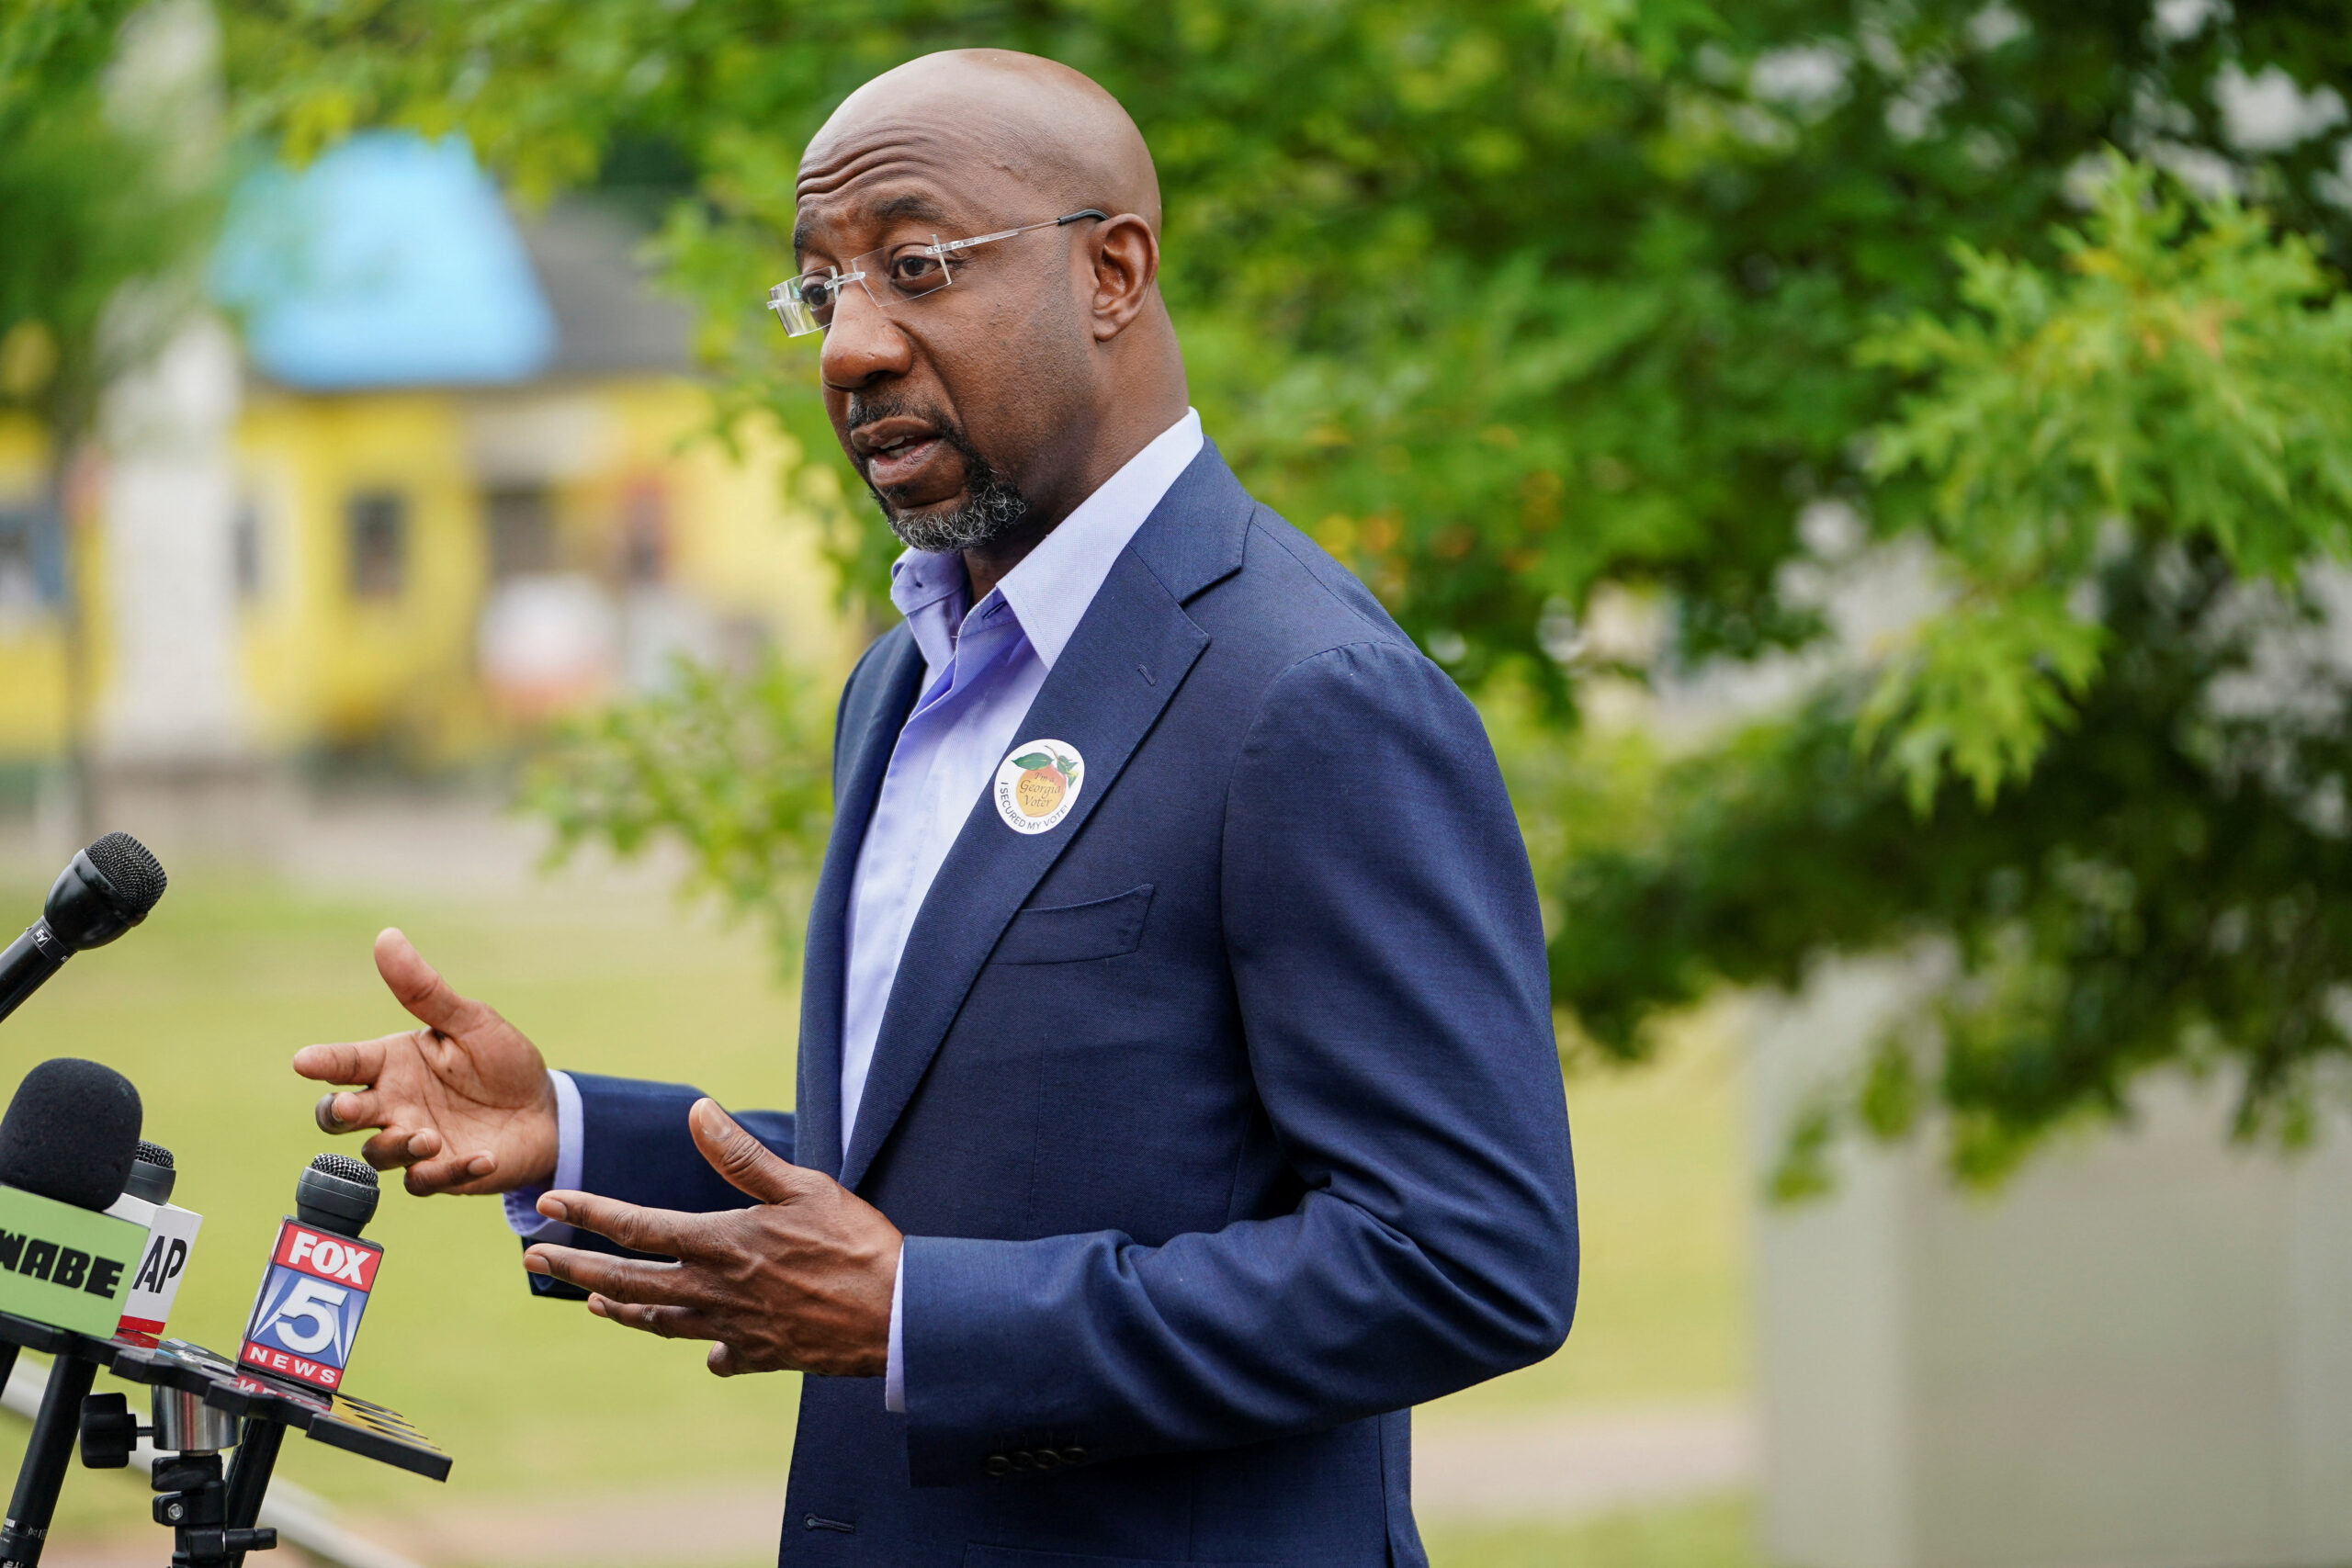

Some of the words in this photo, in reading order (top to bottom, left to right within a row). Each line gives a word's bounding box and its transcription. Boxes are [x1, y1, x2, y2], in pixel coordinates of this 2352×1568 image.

[1020, 779, 1061, 799] Georgia
[1035, 772, 1047, 783] I'm
[1000, 787, 1026, 828] SECURED
[1027, 821, 1042, 830] MY
[1043, 805, 1069, 827] VOTE!
[1023, 795, 1053, 807] Voter
[0, 1228, 125, 1300] WABE
[132, 1235, 187, 1294] AP
[288, 1231, 371, 1285] FOX
[275, 1276, 349, 1355] 5
[249, 1346, 336, 1384] NEWS
